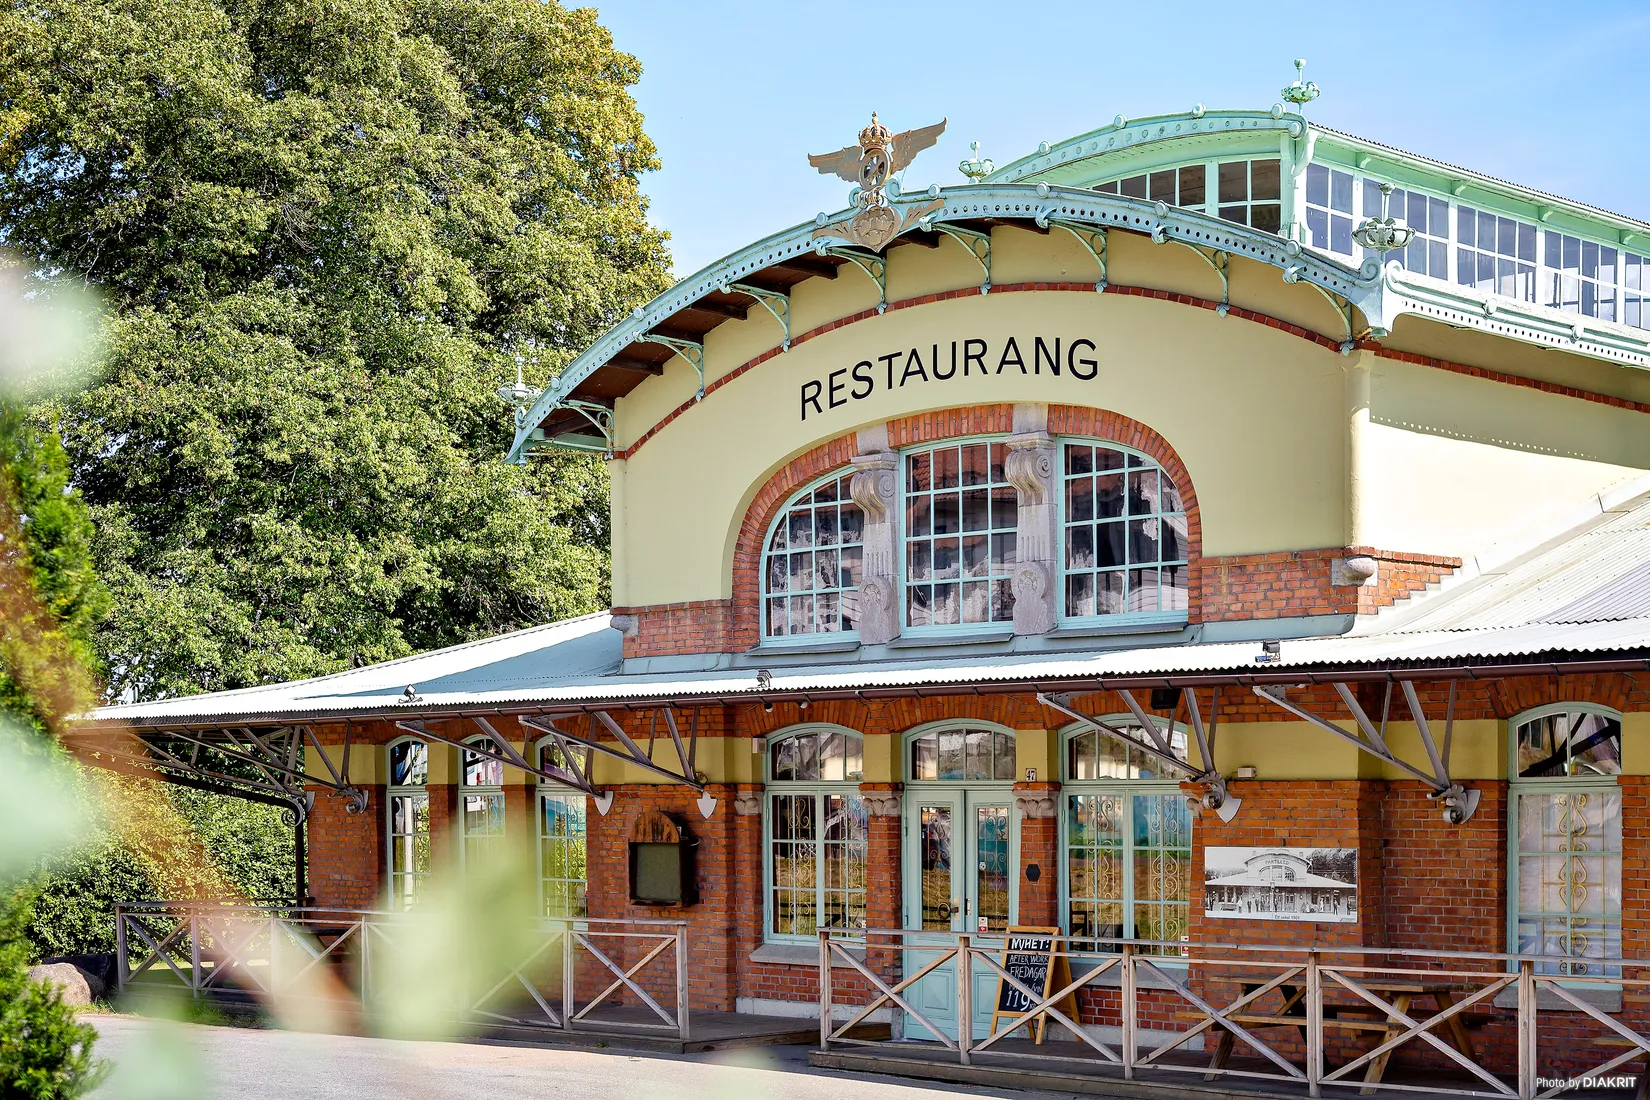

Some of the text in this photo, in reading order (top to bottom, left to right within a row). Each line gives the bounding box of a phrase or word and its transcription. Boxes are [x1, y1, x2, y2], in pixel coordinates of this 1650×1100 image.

[800, 336, 1099, 421] RESTAURANG
[1027, 770, 1035, 780] 47
[1009, 954, 1049, 964] AFTER WORK
[1010, 966, 1046, 981] FREDAGAR
[1006, 990, 1031, 1011] 119
